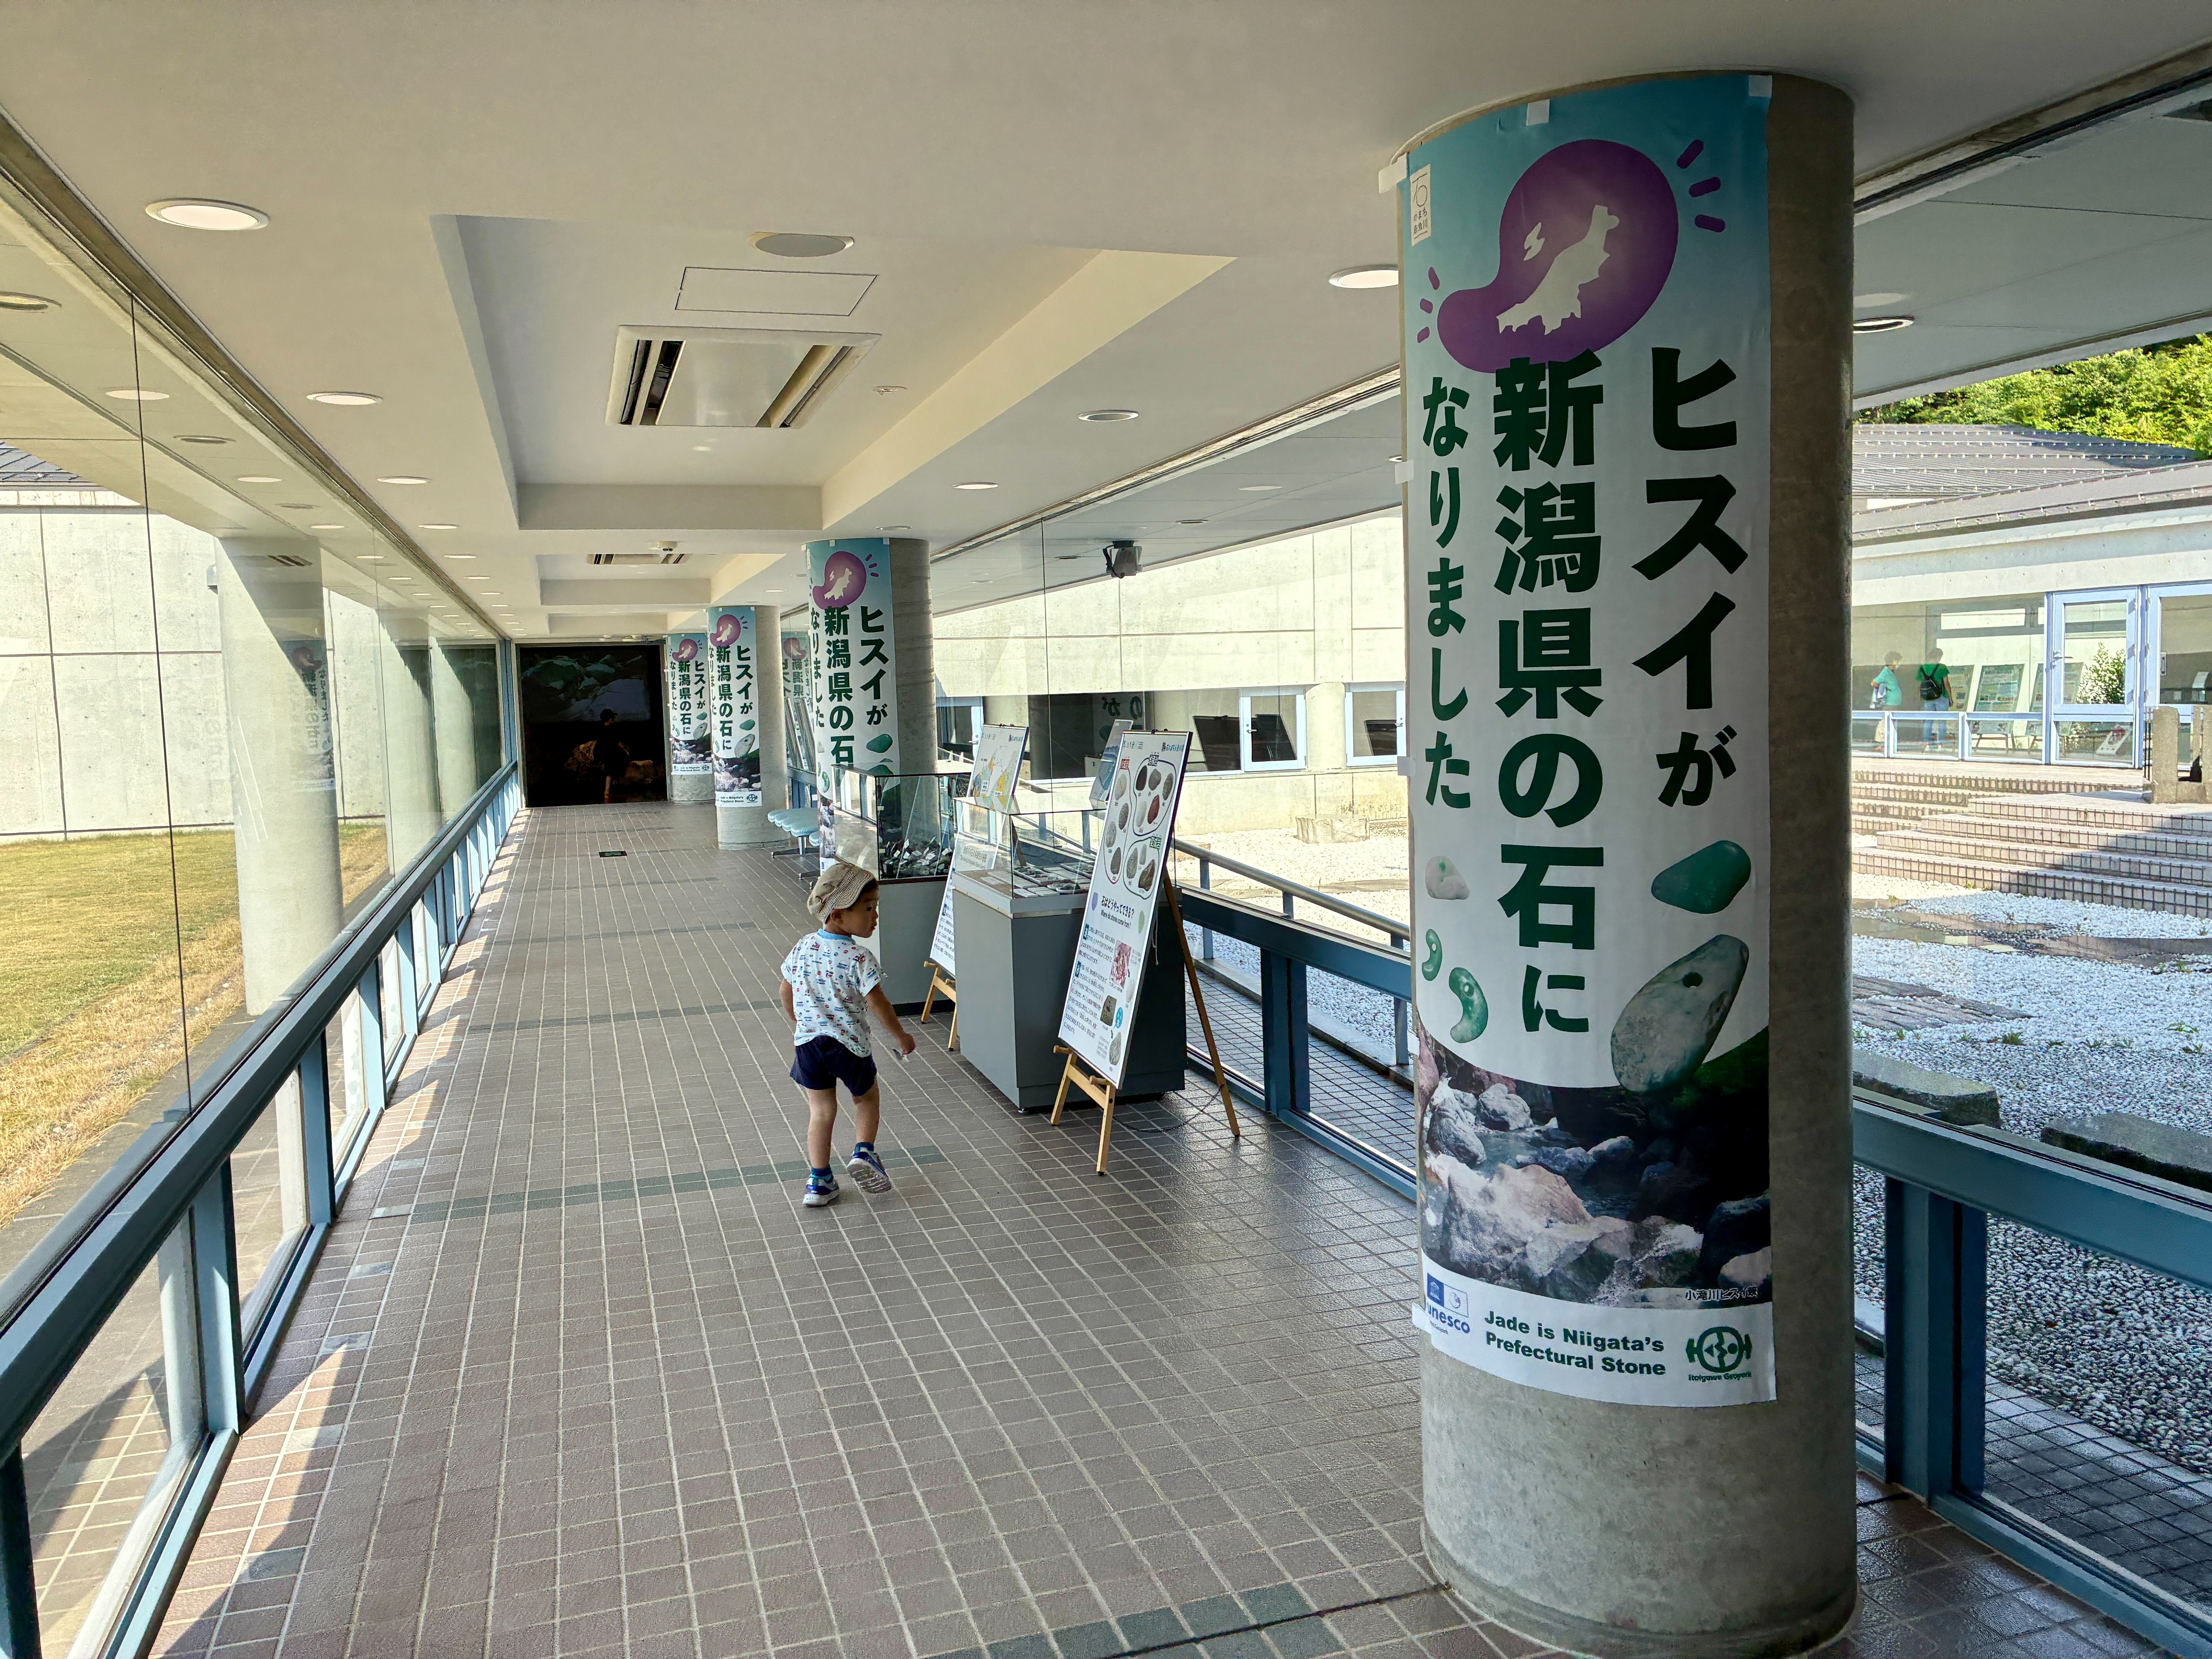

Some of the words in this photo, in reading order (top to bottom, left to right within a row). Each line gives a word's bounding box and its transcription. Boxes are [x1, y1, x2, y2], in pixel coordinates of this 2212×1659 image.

[1423, 377, 1471, 808] なりました
[1632, 347, 1748, 807] ヒスイが
[678, 660, 692, 734] 新潟県の石に
[694, 660, 706, 709] ヒスイが
[709, 645, 717, 715] なりました
[716, 645, 733, 750] 新潟県の石に
[736, 645, 753, 714] ヒスイが
[811, 607, 824, 728] なりました
[824, 605, 854, 767] 新潟県の石
[859, 606, 889, 725] ヒスイが
[1493, 349, 1604, 1032] 新潟県の石に
[1427, 1302, 1470, 1334] unesco
[1484, 1310, 1530, 1334] Jade
[1537, 1322, 1555, 1340] is
[1563, 1328, 1664, 1352] Niigata's
[1486, 1331, 1594, 1370] Prefectural
[1601, 1357, 1666, 1375] Stone
